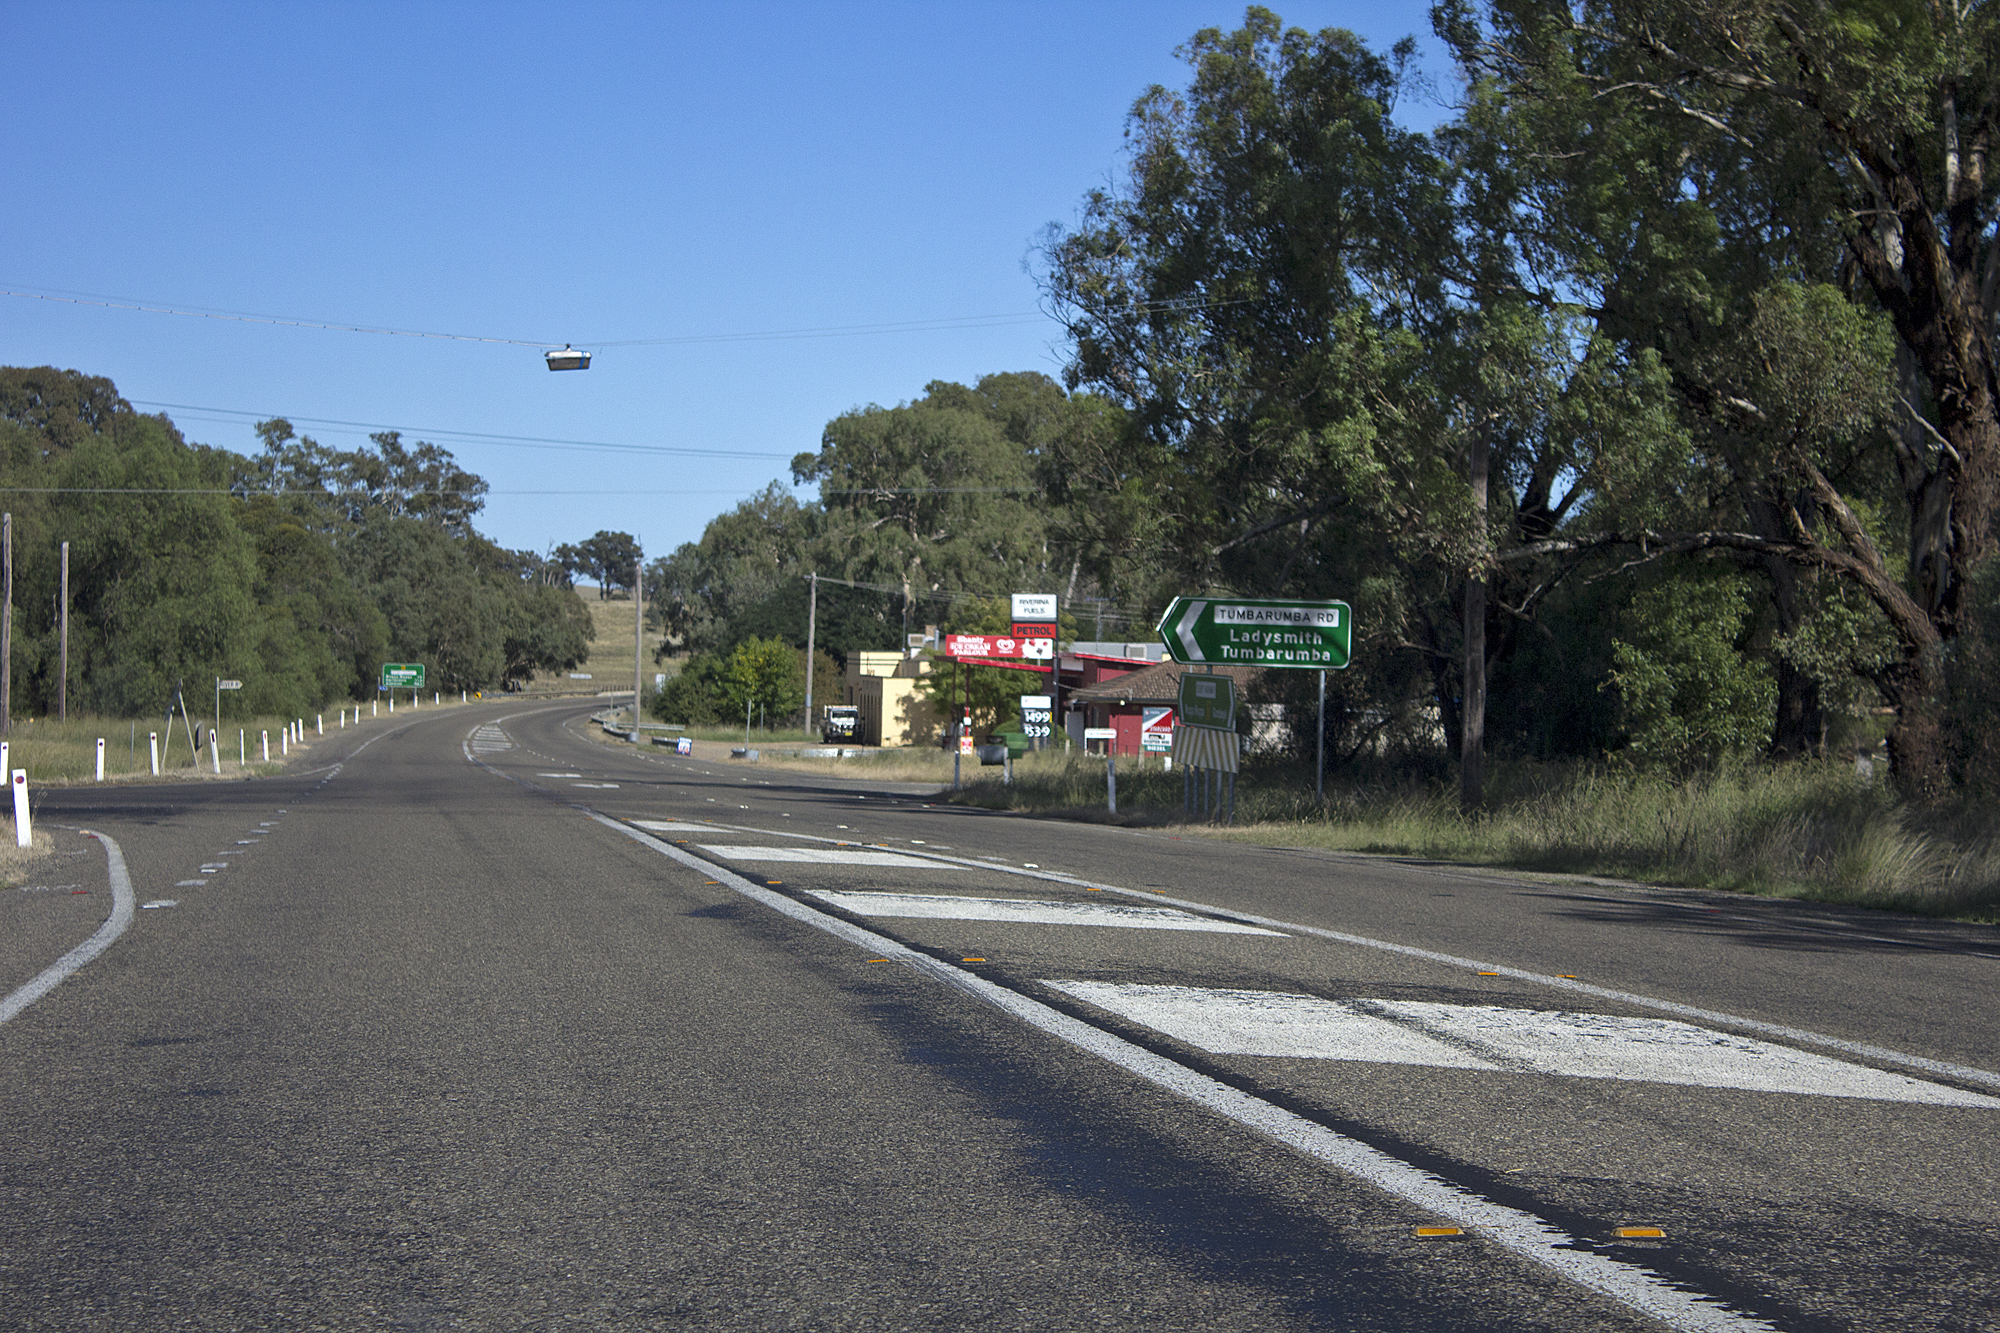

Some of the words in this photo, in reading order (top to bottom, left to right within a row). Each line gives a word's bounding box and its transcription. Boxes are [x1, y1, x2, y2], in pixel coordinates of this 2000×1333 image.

[1219, 609, 1311, 623] TUMBARUMBA
[1317, 612, 1335, 623] RD
[1016, 626, 1053, 636] PETROL
[1230, 628, 1323, 647] Ladysmith
[964, 642, 991, 651] CREAM
[1220, 645, 1332, 662] Tumbarumba
